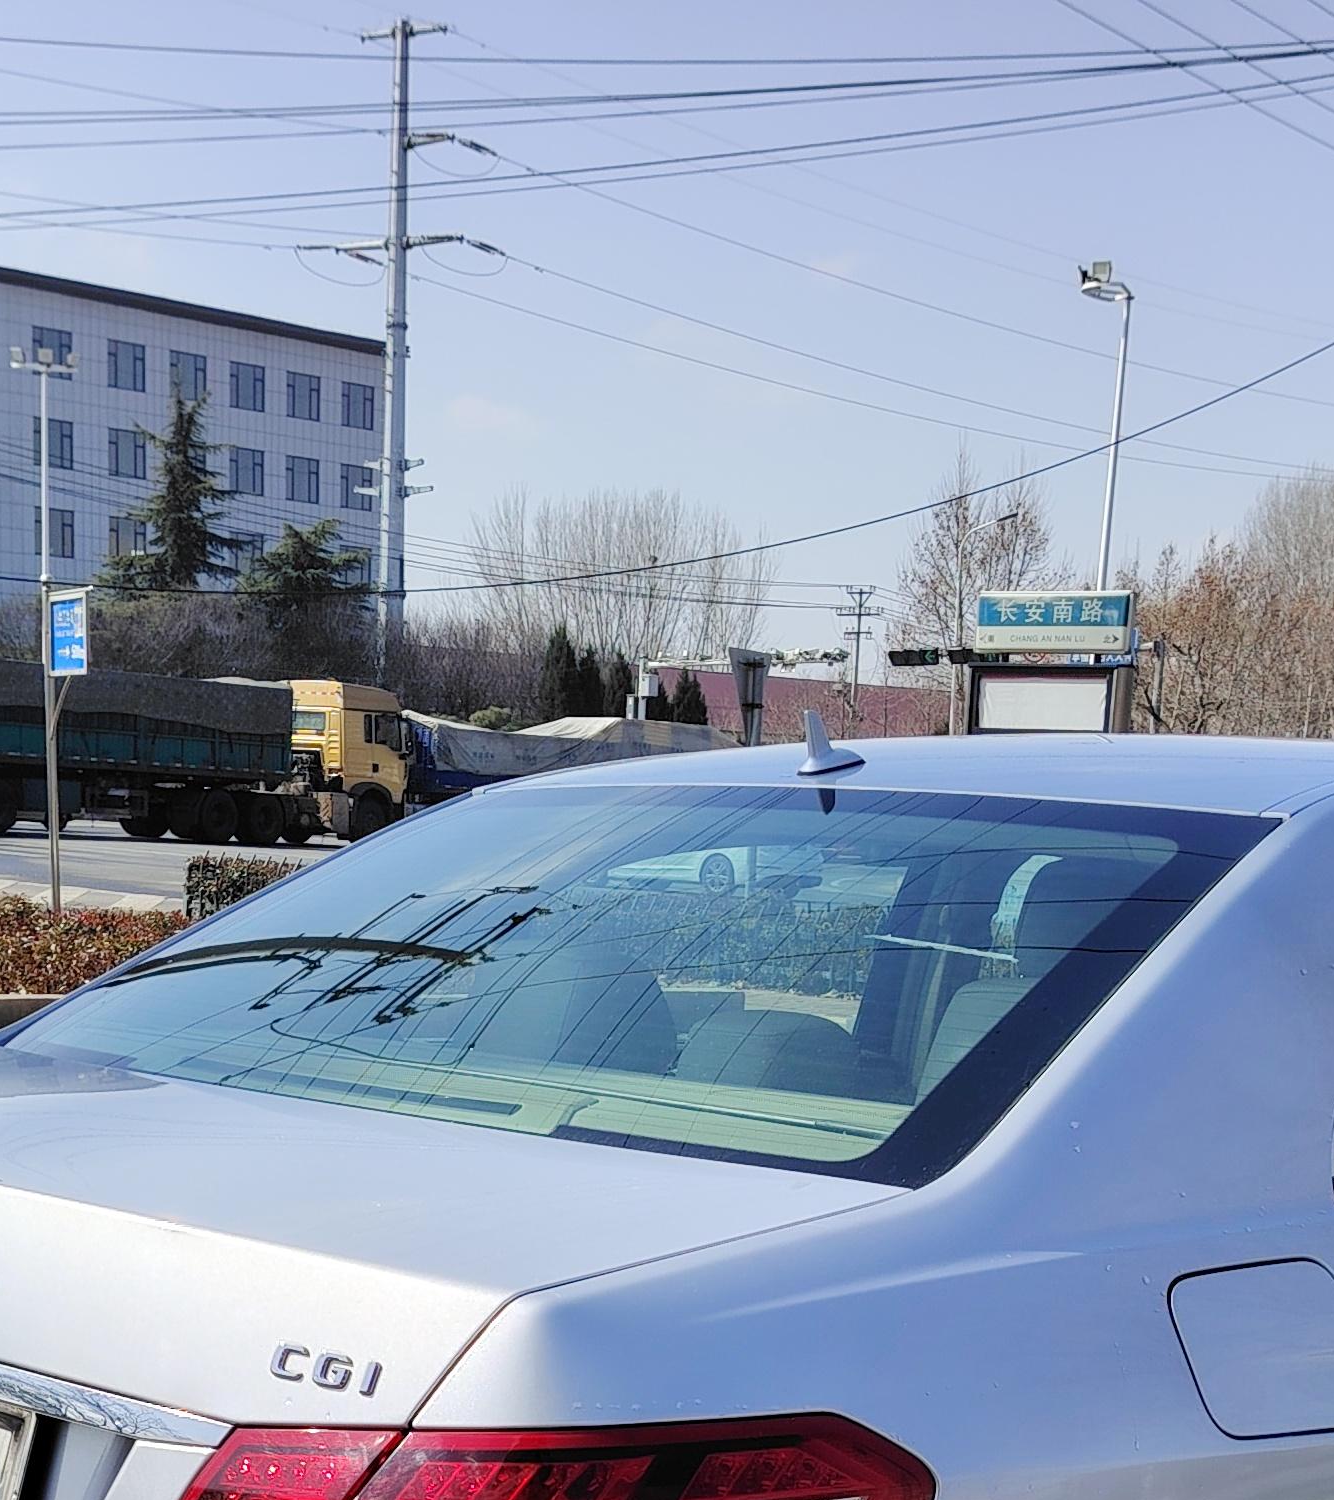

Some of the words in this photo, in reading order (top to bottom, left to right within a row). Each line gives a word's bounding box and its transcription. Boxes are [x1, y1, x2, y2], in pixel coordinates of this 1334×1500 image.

[996, 598, 1104, 624] 长安南路
[1010, 635, 1038, 643] CHANG
[1041, 635, 1052, 643] AN
[1054, 635, 1072, 643] NAN
[1074, 635, 1085, 643] LU
[269, 1340, 383, 1397] CGI
